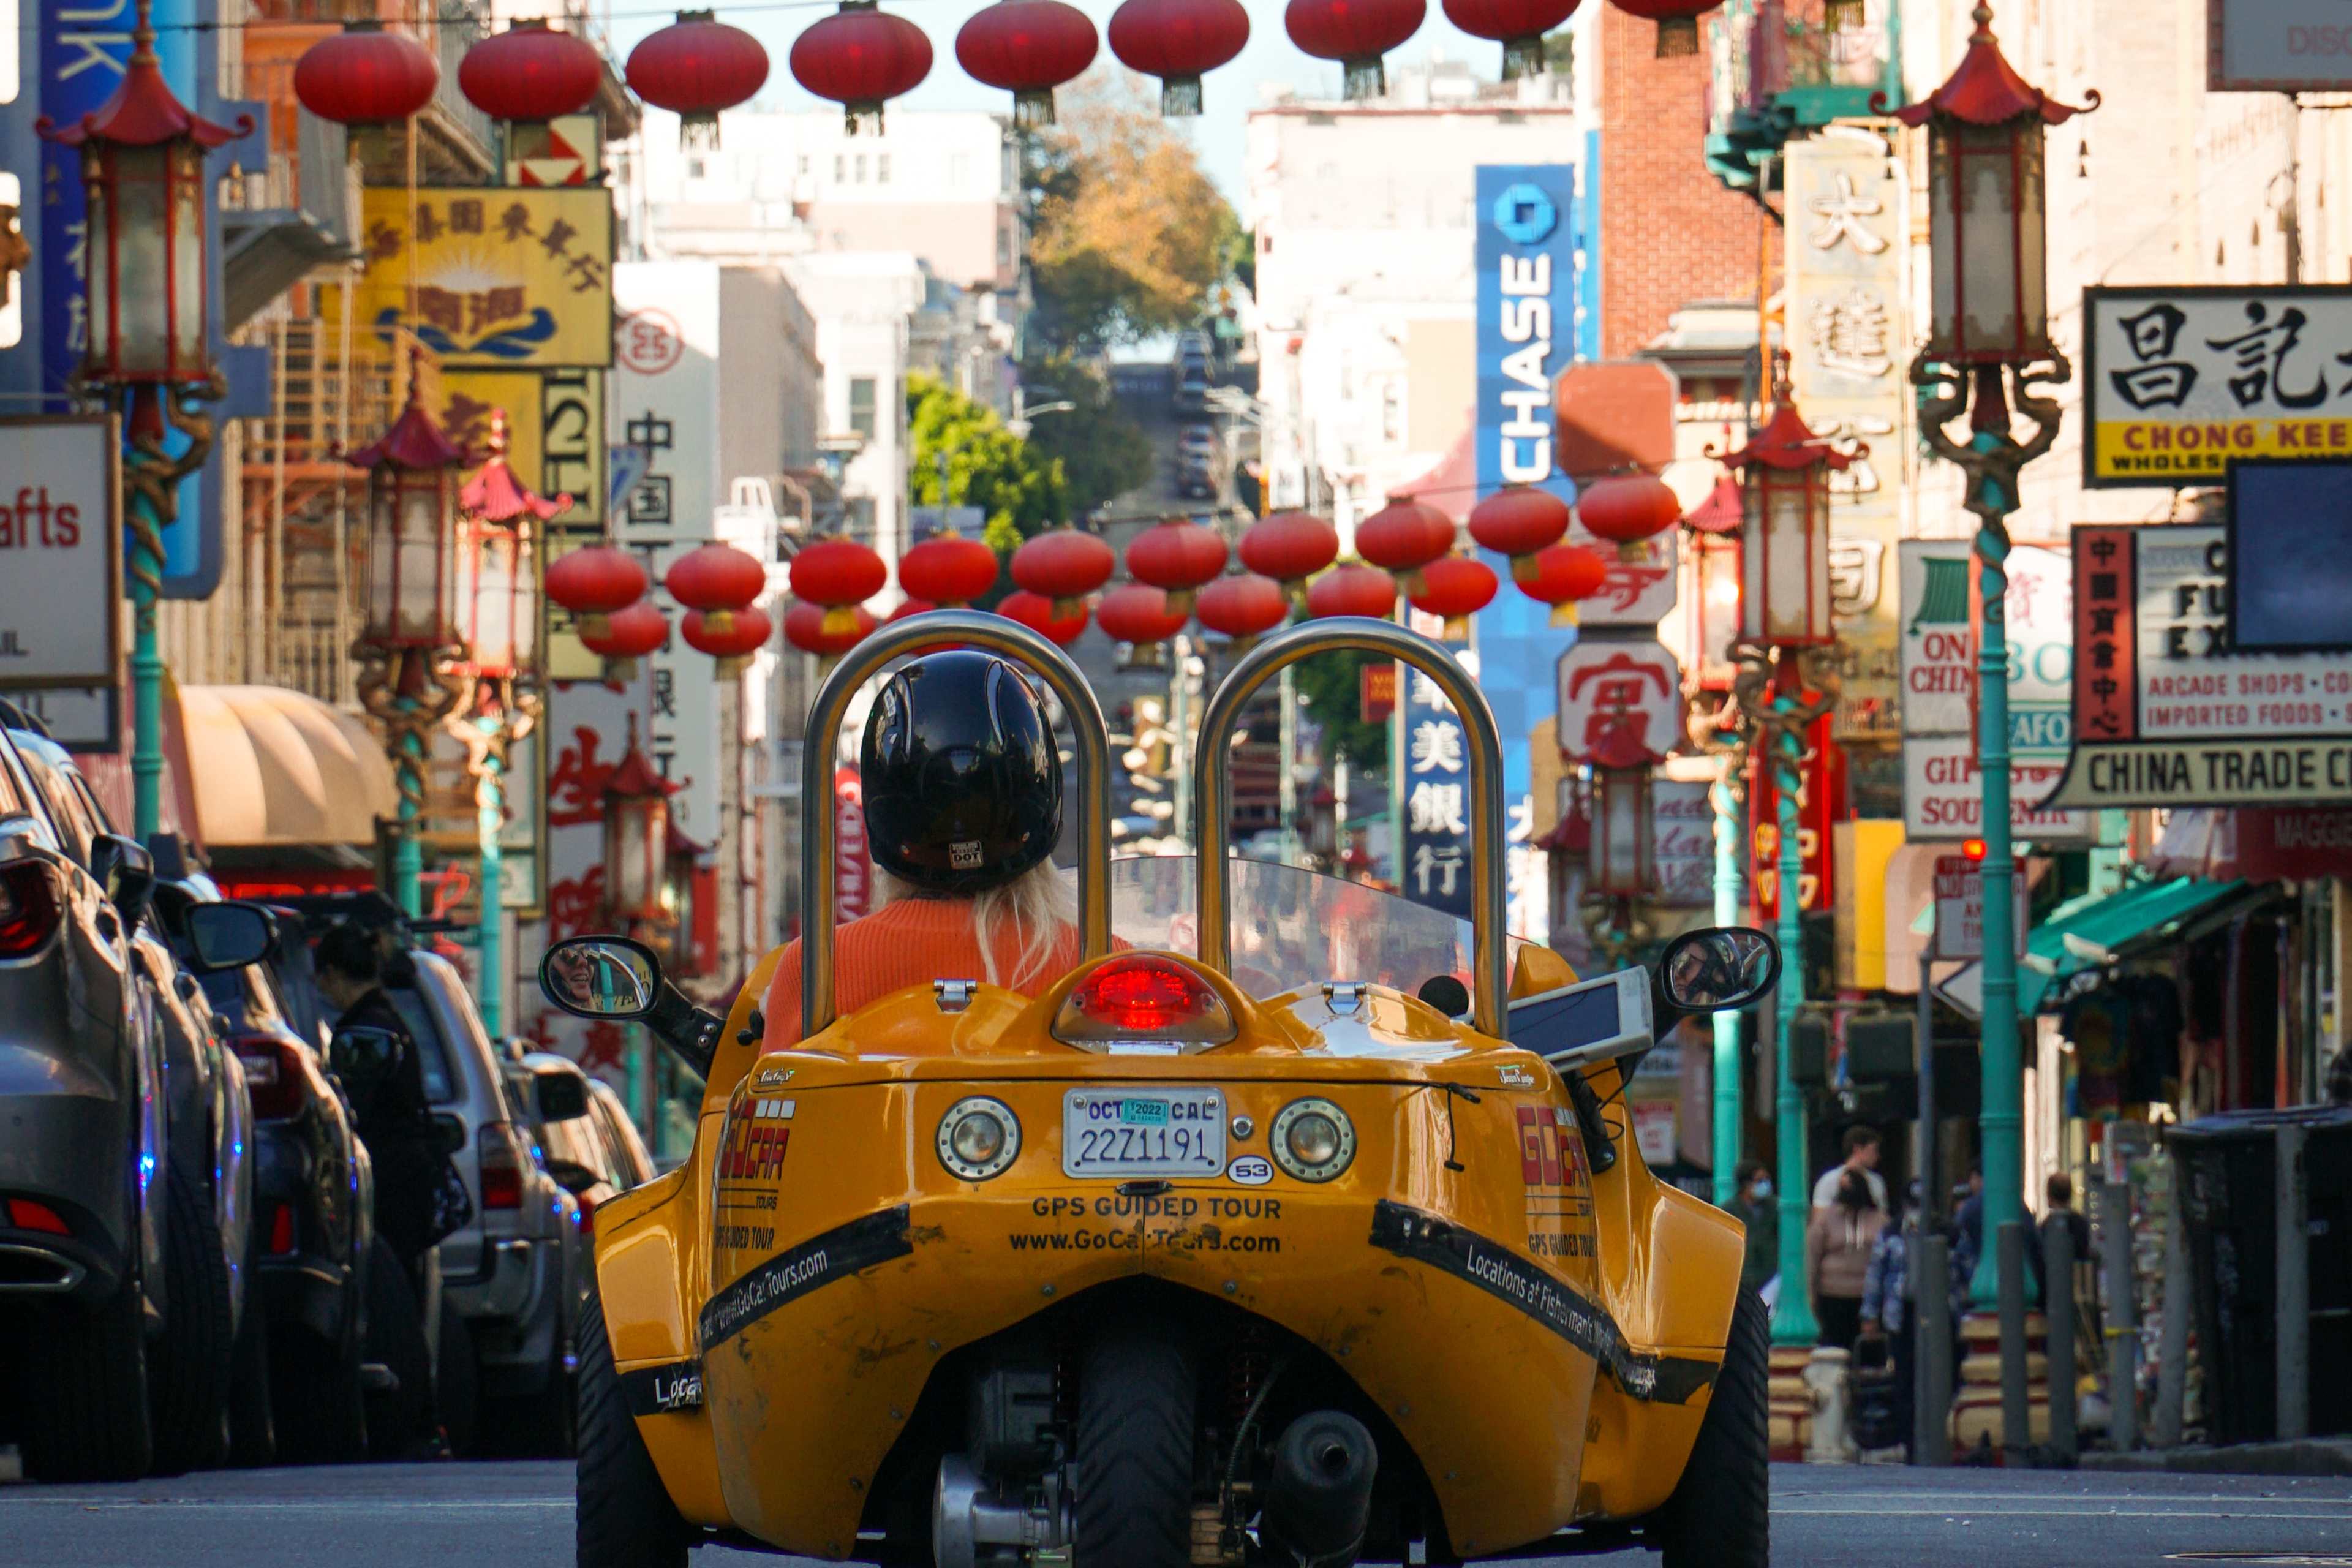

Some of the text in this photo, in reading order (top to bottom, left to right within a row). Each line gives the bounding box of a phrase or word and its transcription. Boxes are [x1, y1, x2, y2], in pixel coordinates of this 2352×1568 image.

[1500, 252, 1551, 483] CHASE
[2124, 422, 2347, 450] CHONG KEE
[2148, 674, 2228, 696] ARCADE
[2238, 673, 2304, 695] SHOPS
[2147, 703, 2250, 727] IMPORTED
[2258, 701, 2323, 724] FOODS
[2008, 712, 2071, 745] AFO
[2089, 747, 2352, 793] CHINA TRADE C
[1921, 797, 2068, 825] SOUENIR
[1089, 1101, 1123, 1120] OCT
[1136, 1104, 1161, 1115] 2022
[1172, 1102, 1213, 1120] CAL
[1080, 1128, 1209, 1162] 22Z1191
[1235, 1164, 1268, 1177] 53
[755, 1195, 777, 1210] TOURS
[1032, 1197, 1281, 1218] GPS GUIDED TOUR
[752, 1226, 774, 1250] TOUR
[1529, 1233, 1548, 1256] GPS
[1548, 1234, 1578, 1256] GUIDED
[1467, 1244, 1526, 1300] Locations
